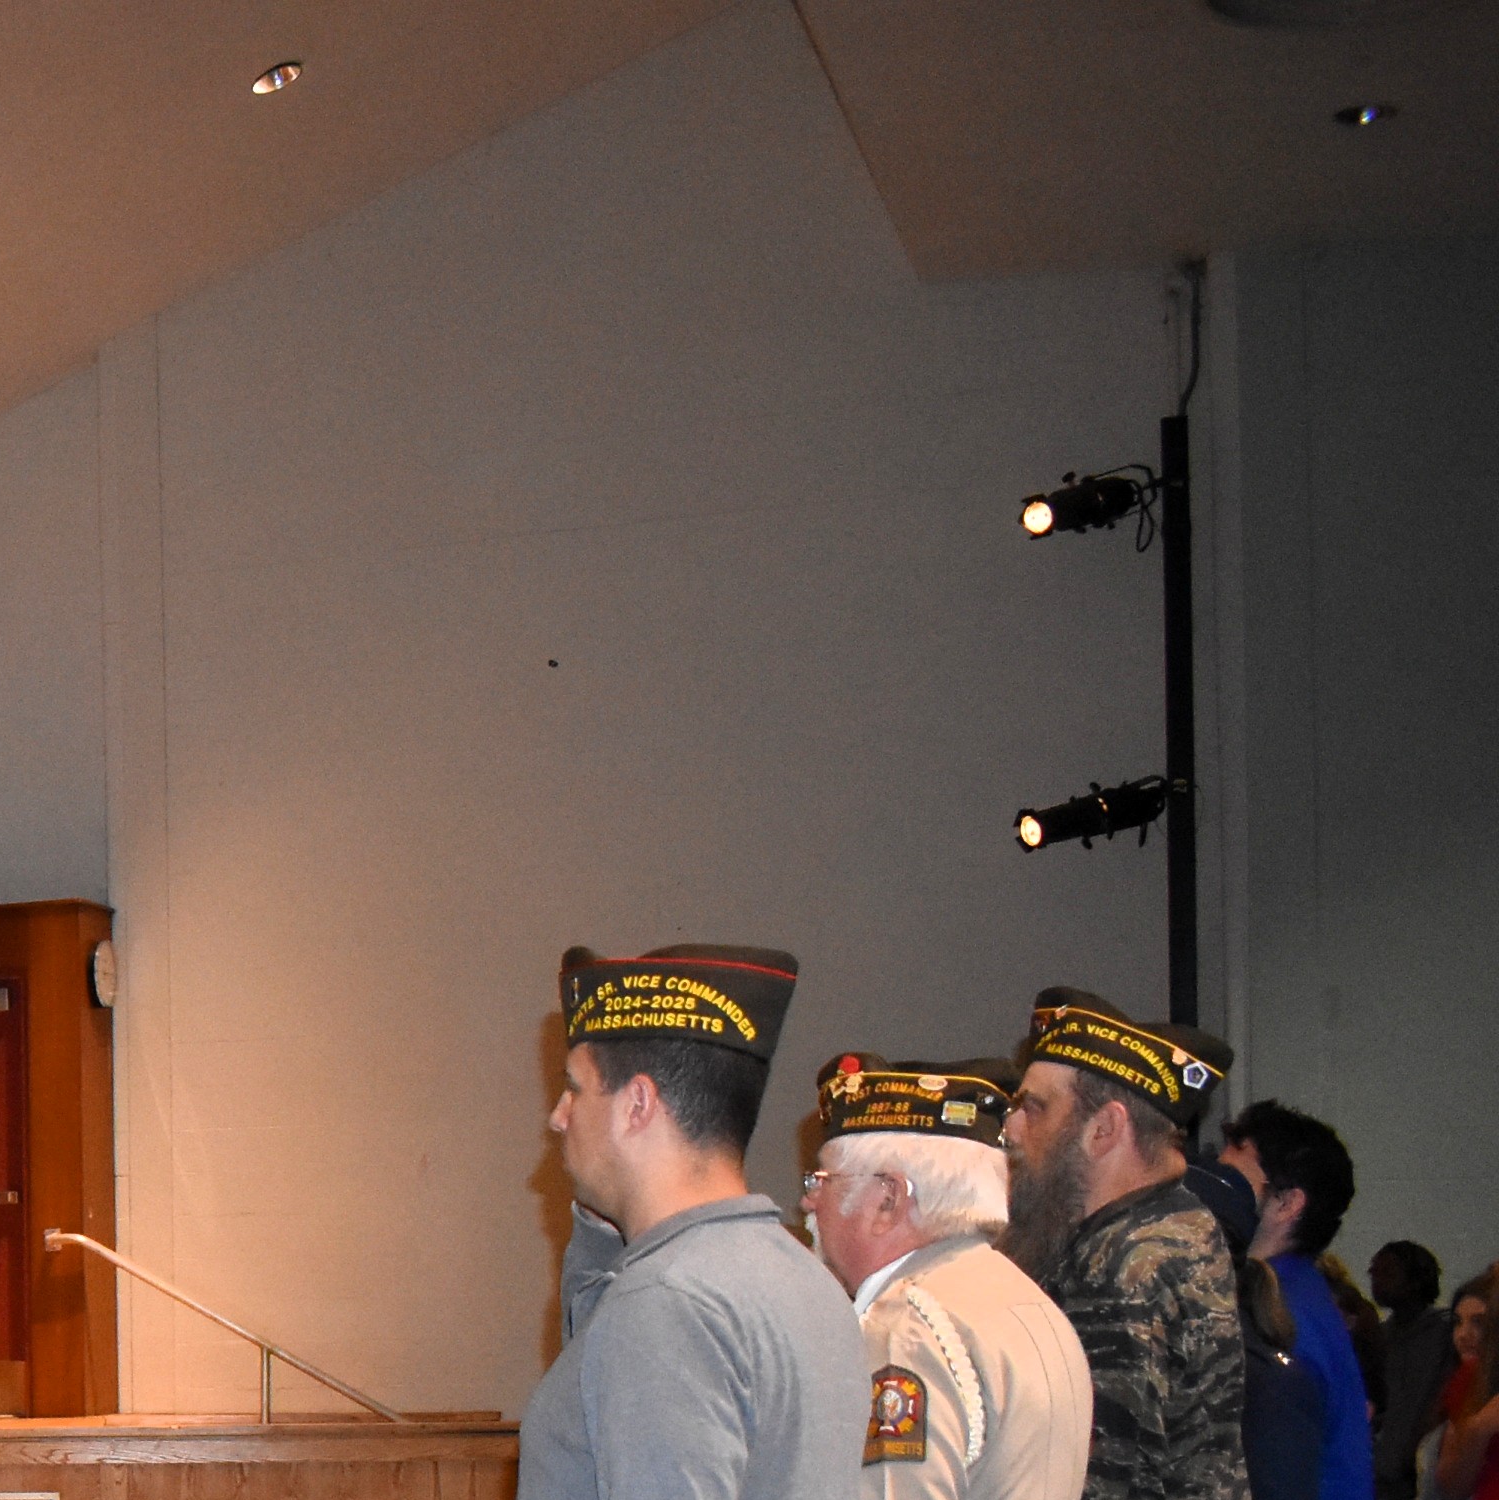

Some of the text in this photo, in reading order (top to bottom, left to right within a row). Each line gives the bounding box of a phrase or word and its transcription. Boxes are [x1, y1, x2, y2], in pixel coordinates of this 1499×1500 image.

[597, 982, 617, 1000] SR.
[622, 975, 662, 990] VICE
[665, 976, 758, 1042] COMMANDER
[605, 995, 696, 1012] 2024-2025
[584, 1012, 725, 1034] MASSACHUSETTS
[1046, 1043, 1161, 1095] MASSACHUSETTS
[1086, 1023, 1119, 1042] VICE
[1119, 1036, 1181, 1103] COMMANDER
[842, 1111, 935, 1128] MASSACHUSETTS
